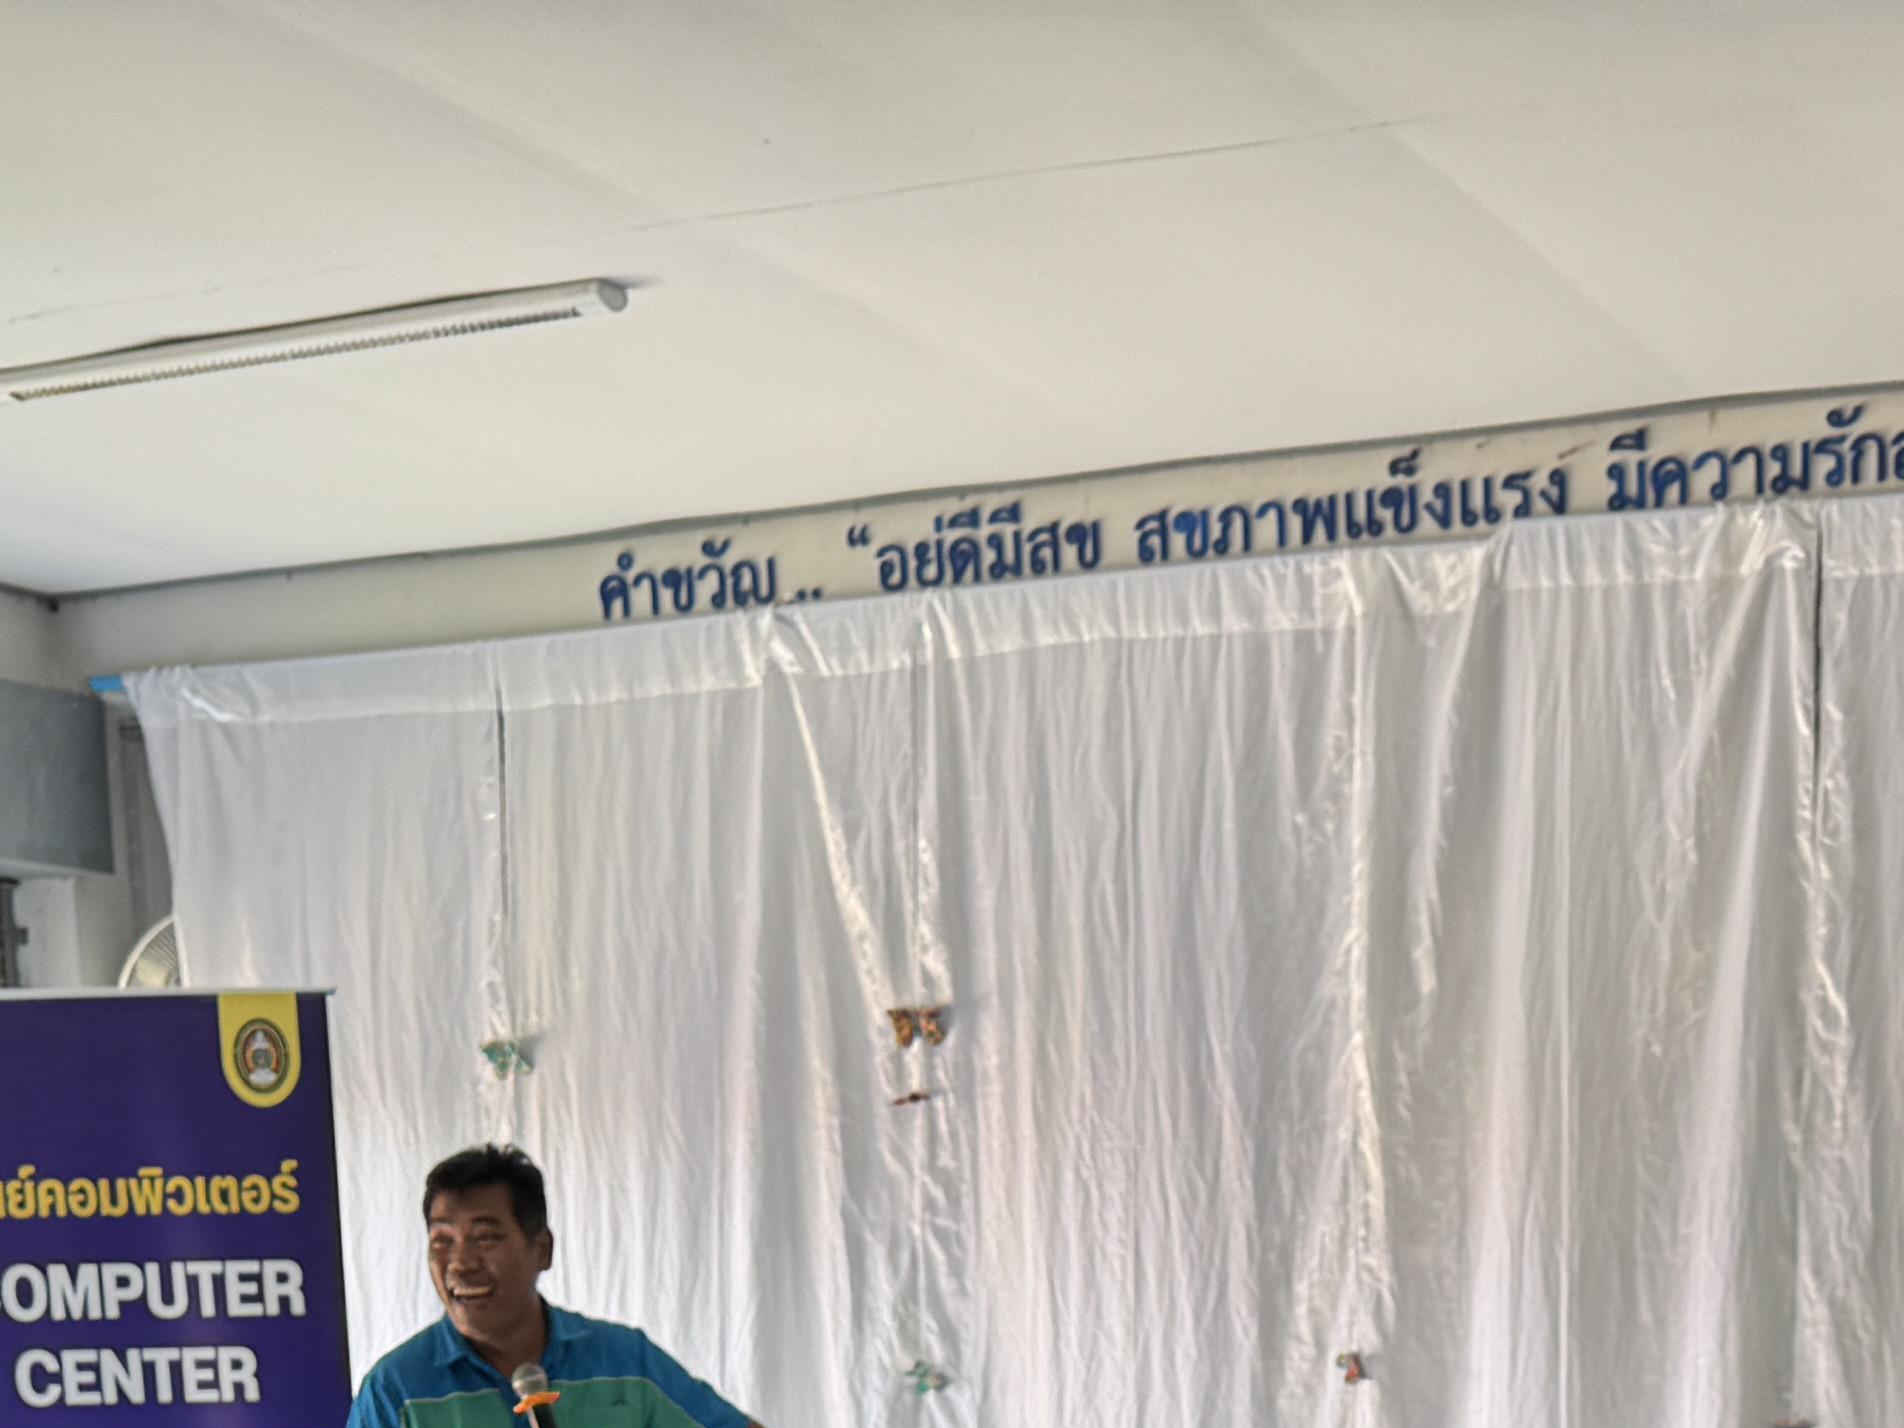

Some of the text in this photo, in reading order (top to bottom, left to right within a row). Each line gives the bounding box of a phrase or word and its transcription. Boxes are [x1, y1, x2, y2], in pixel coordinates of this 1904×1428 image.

[1134, 446, 1569, 565] สขภาพแข็งแรง
[13, 1345, 262, 1409] CENTER
